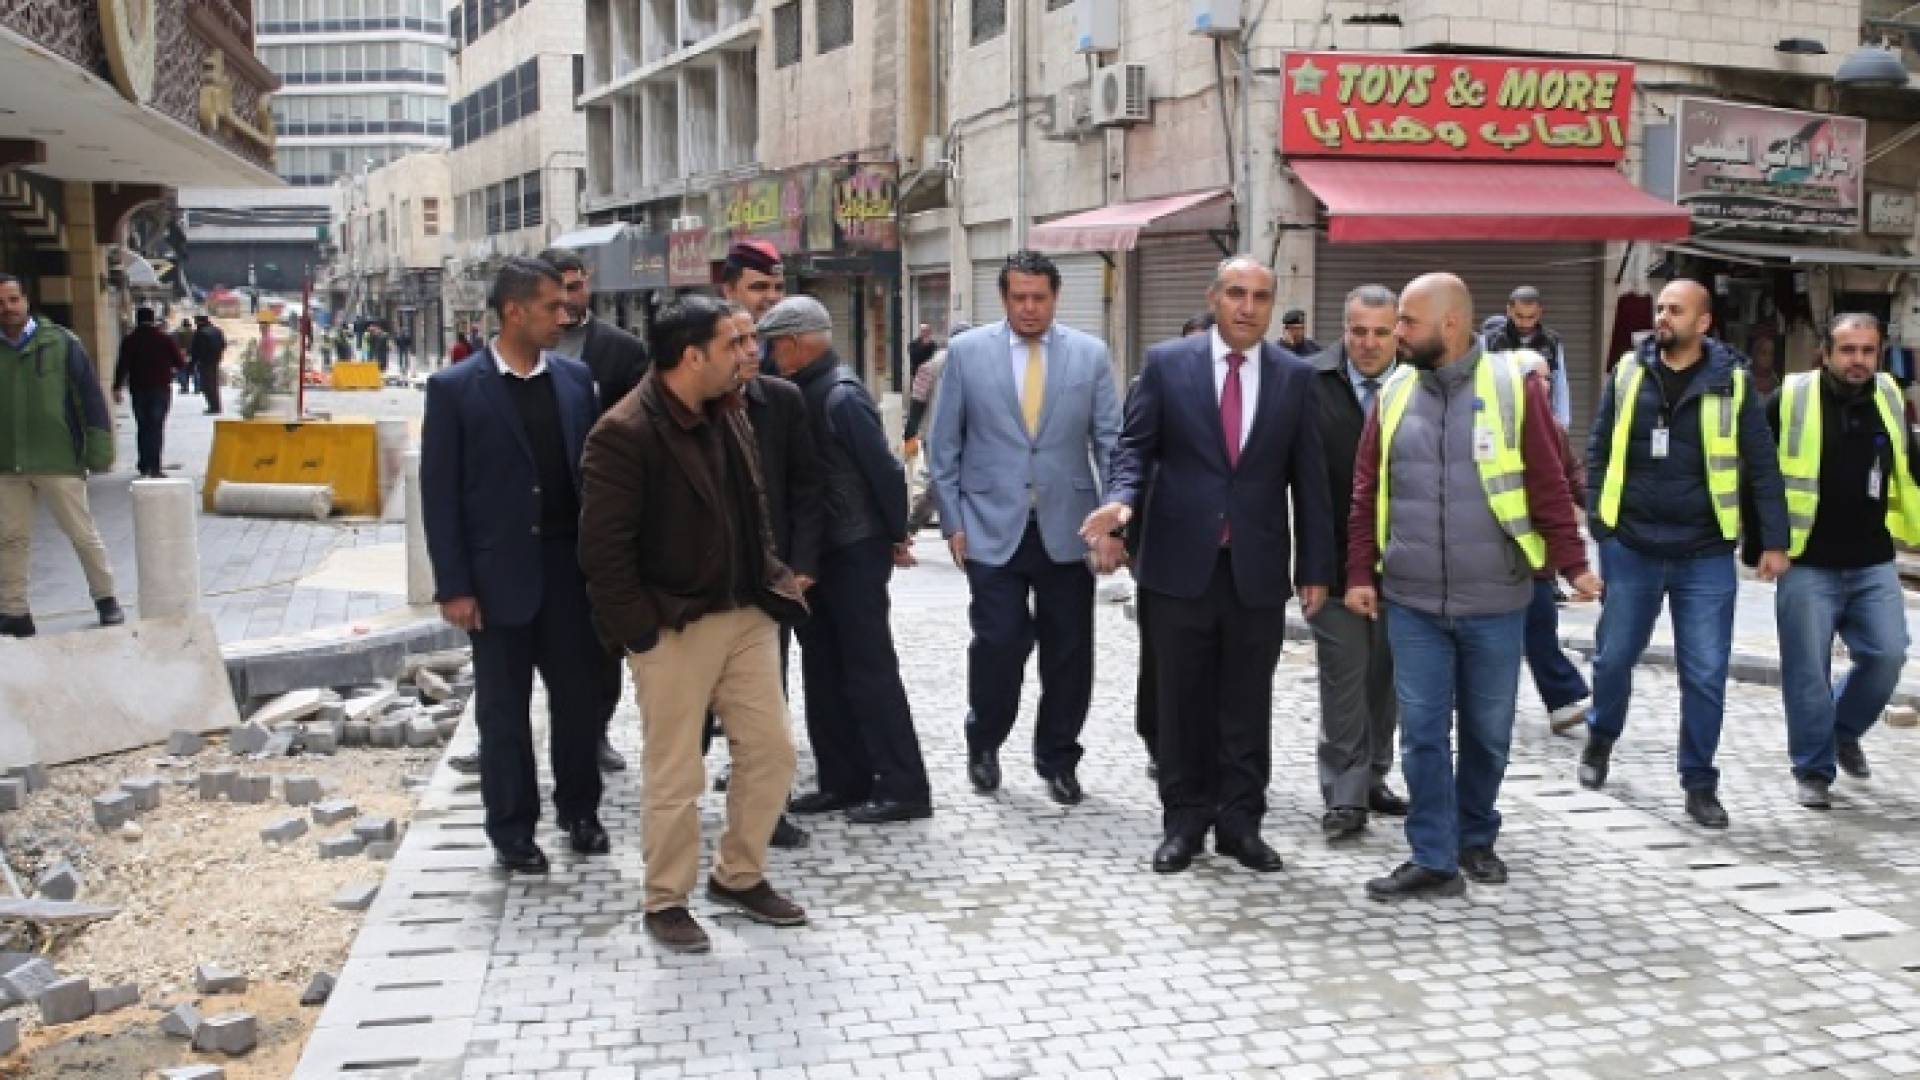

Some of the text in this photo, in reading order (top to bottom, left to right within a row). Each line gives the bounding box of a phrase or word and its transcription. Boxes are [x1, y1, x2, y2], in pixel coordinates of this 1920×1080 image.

[1336, 65, 1620, 112] TOYS & MORE
[1302, 108, 1625, 149] العاب وهدايا
